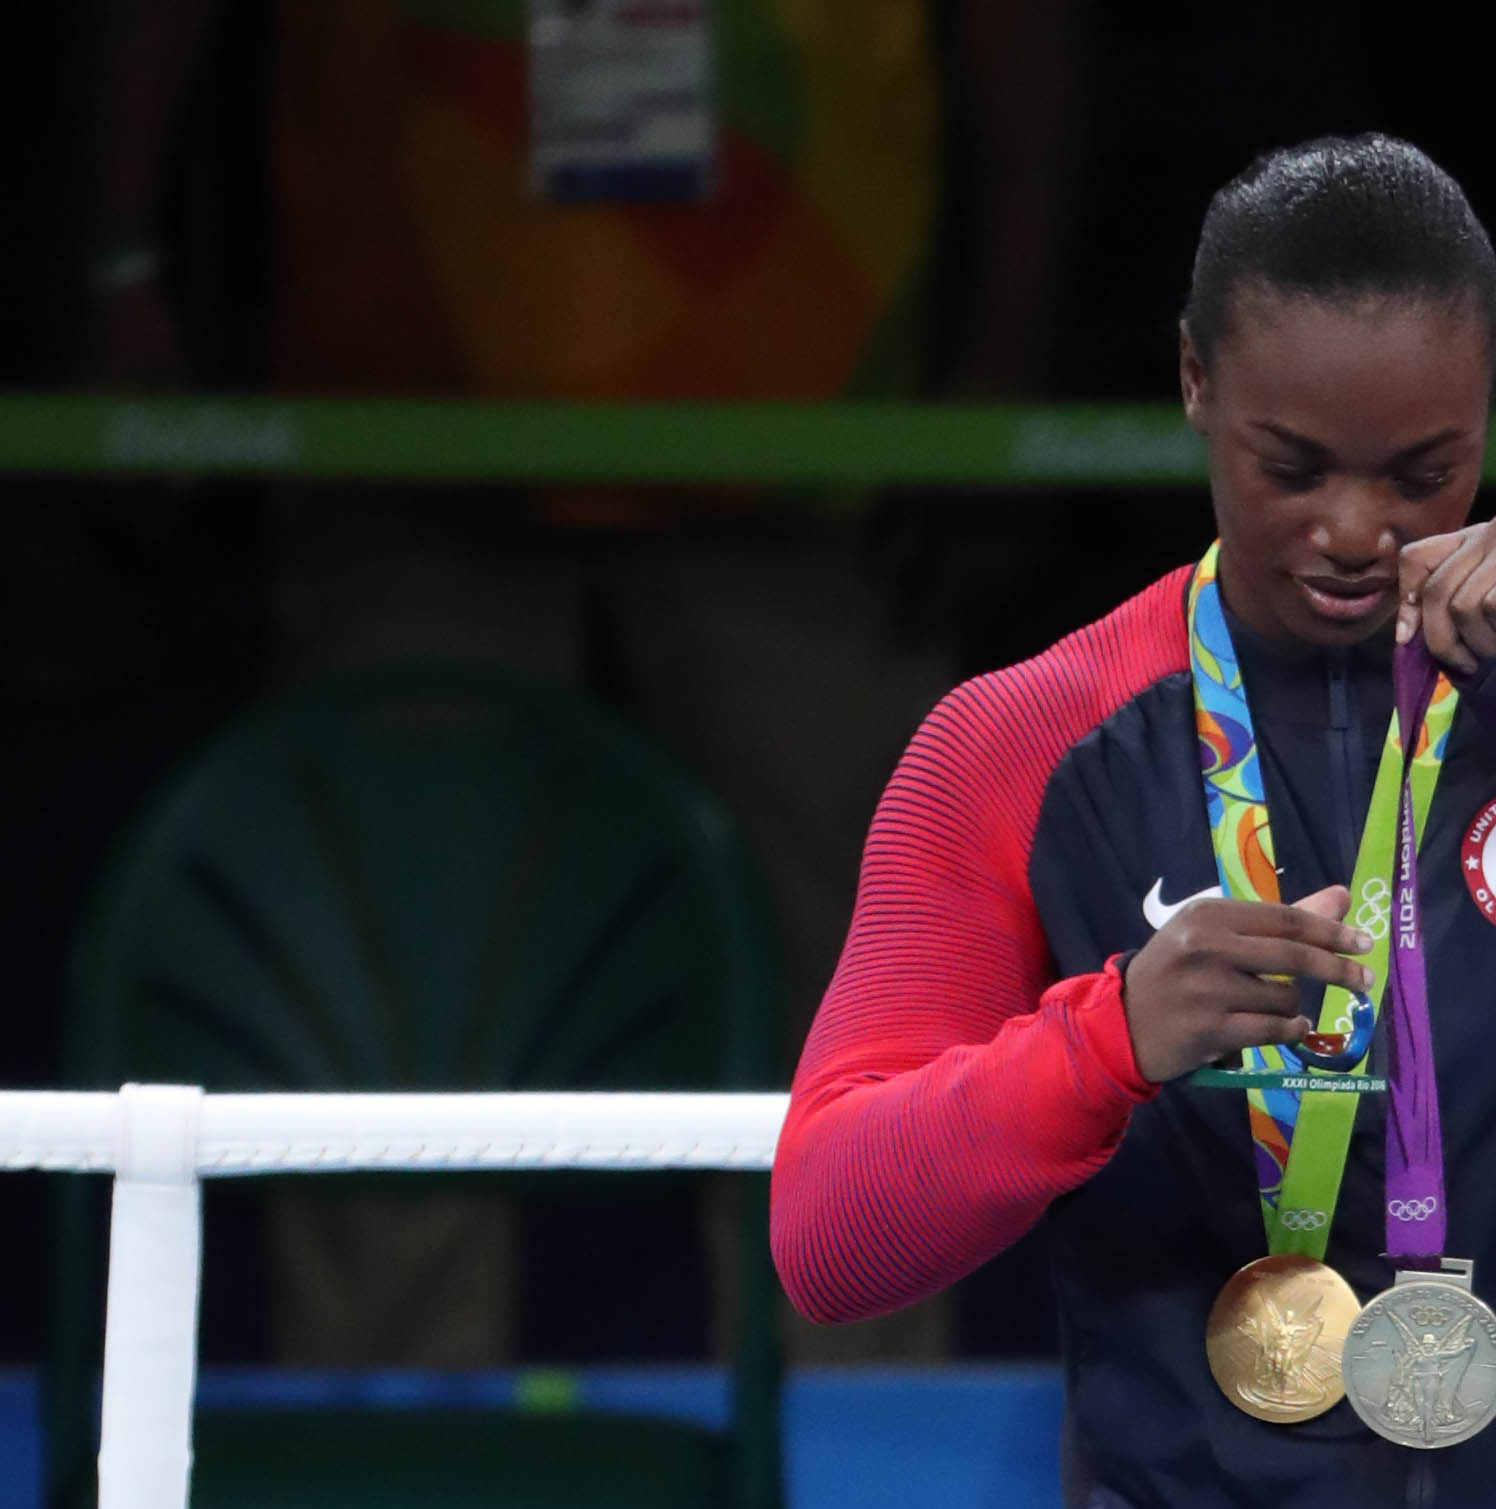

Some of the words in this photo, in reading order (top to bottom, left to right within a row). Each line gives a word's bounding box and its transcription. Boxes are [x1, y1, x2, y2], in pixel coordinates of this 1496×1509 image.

[1400, 888, 1416, 949] 2012
[1282, 1078, 1307, 1089] XXXI
[1309, 1078, 1356, 1092] Olimpiada
[1357, 1079, 1370, 1090] Rio
[1371, 1080, 1386, 1091] 2016
